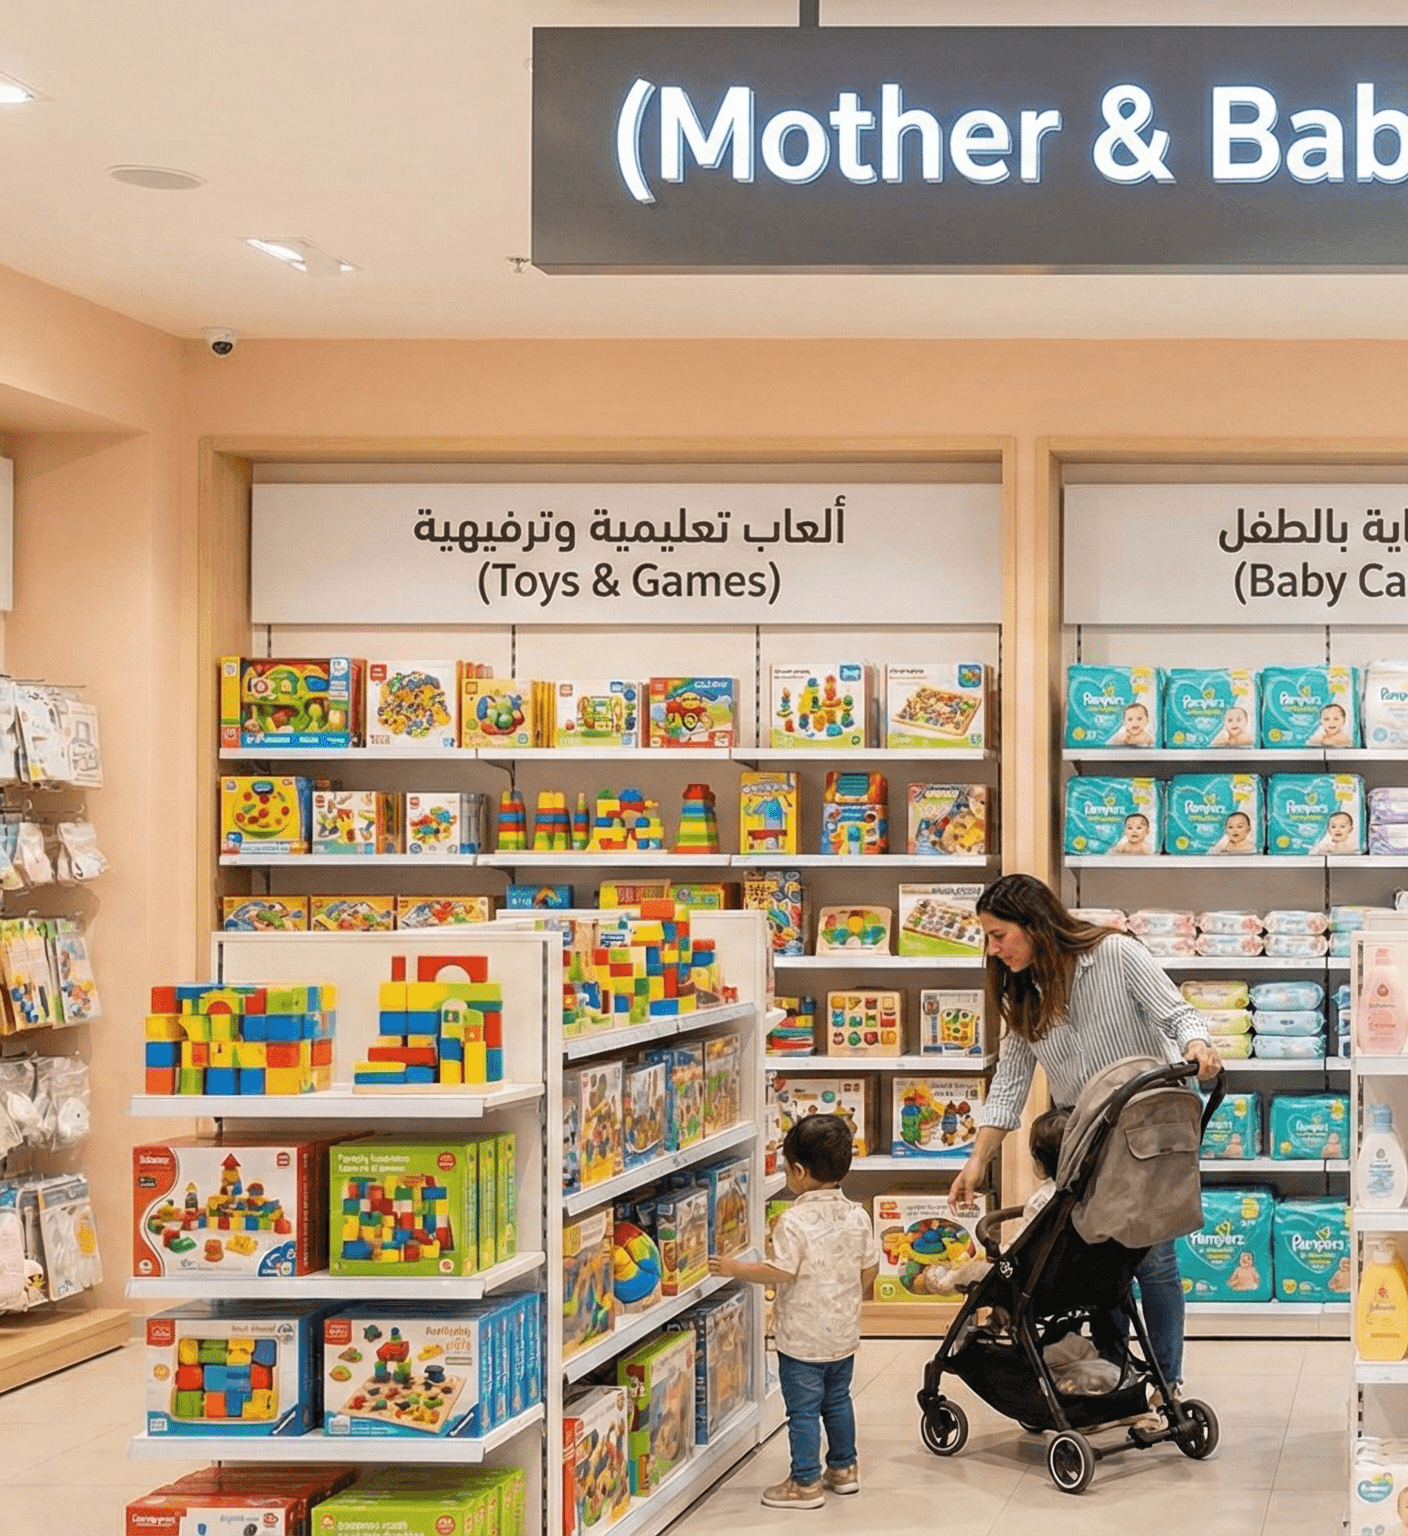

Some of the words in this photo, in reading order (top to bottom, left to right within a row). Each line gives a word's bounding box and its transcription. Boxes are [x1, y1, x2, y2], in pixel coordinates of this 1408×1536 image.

[616, 79, 1061, 201] (Mother
[1092, 84, 1175, 184] &
[413, 508, 576, 554] وترفيهية
[589, 508, 731, 553] تعليمية
[743, 495, 846, 553] ألعاب
[1218, 508, 1348, 553] بالطفل
[478, 561, 580, 606] (Toys
[592, 562, 621, 598] &
[632, 561, 781, 605] Games)
[1234, 561, 1348, 607] (Baby
